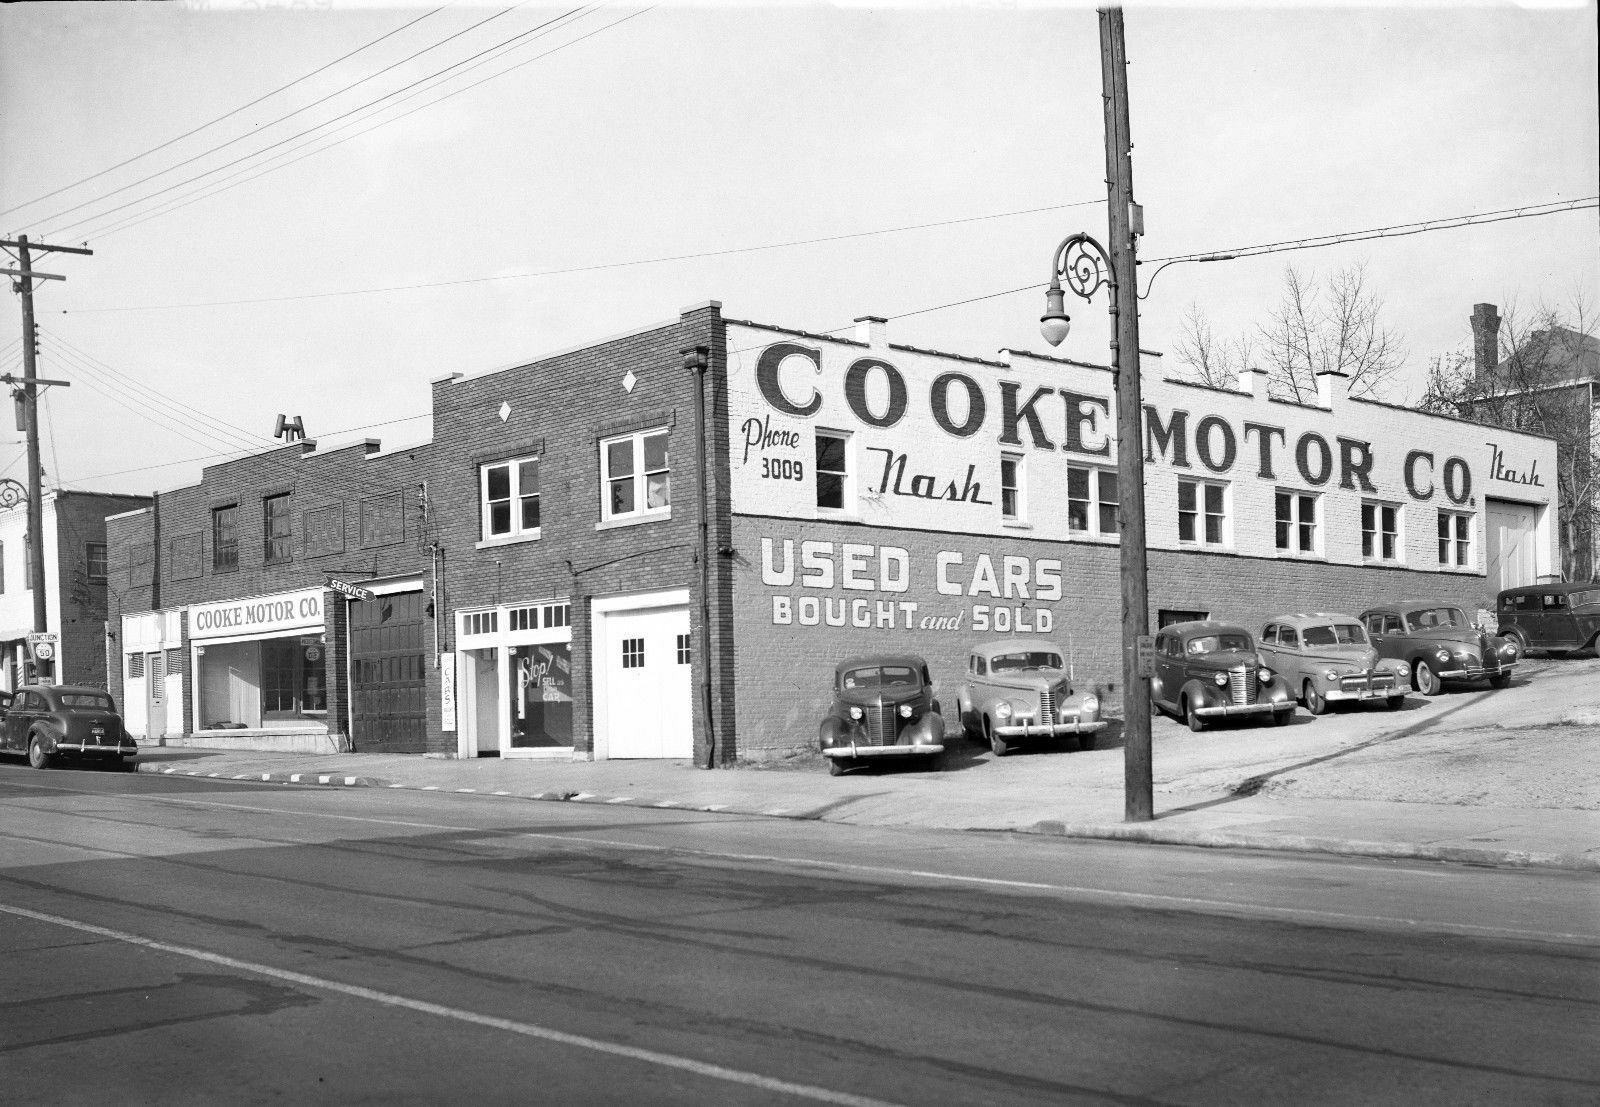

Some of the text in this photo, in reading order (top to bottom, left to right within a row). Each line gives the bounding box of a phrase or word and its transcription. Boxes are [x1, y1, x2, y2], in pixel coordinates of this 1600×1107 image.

[741, 414, 800, 465] Phone
[755, 341, 1476, 508] COOKE MOTOR CO.
[761, 457, 803, 482] 3009
[866, 446, 993, 505] Nash
[1485, 442, 1545, 488] Nash
[330, 579, 368, 599] SERVICE
[761, 537, 1063, 601] USED CARS
[196, 596, 320, 631] COOKE MOTOR CO.
[772, 595, 1054, 633] BOUGHT and SOLD
[521, 654, 554, 689] Stop!
